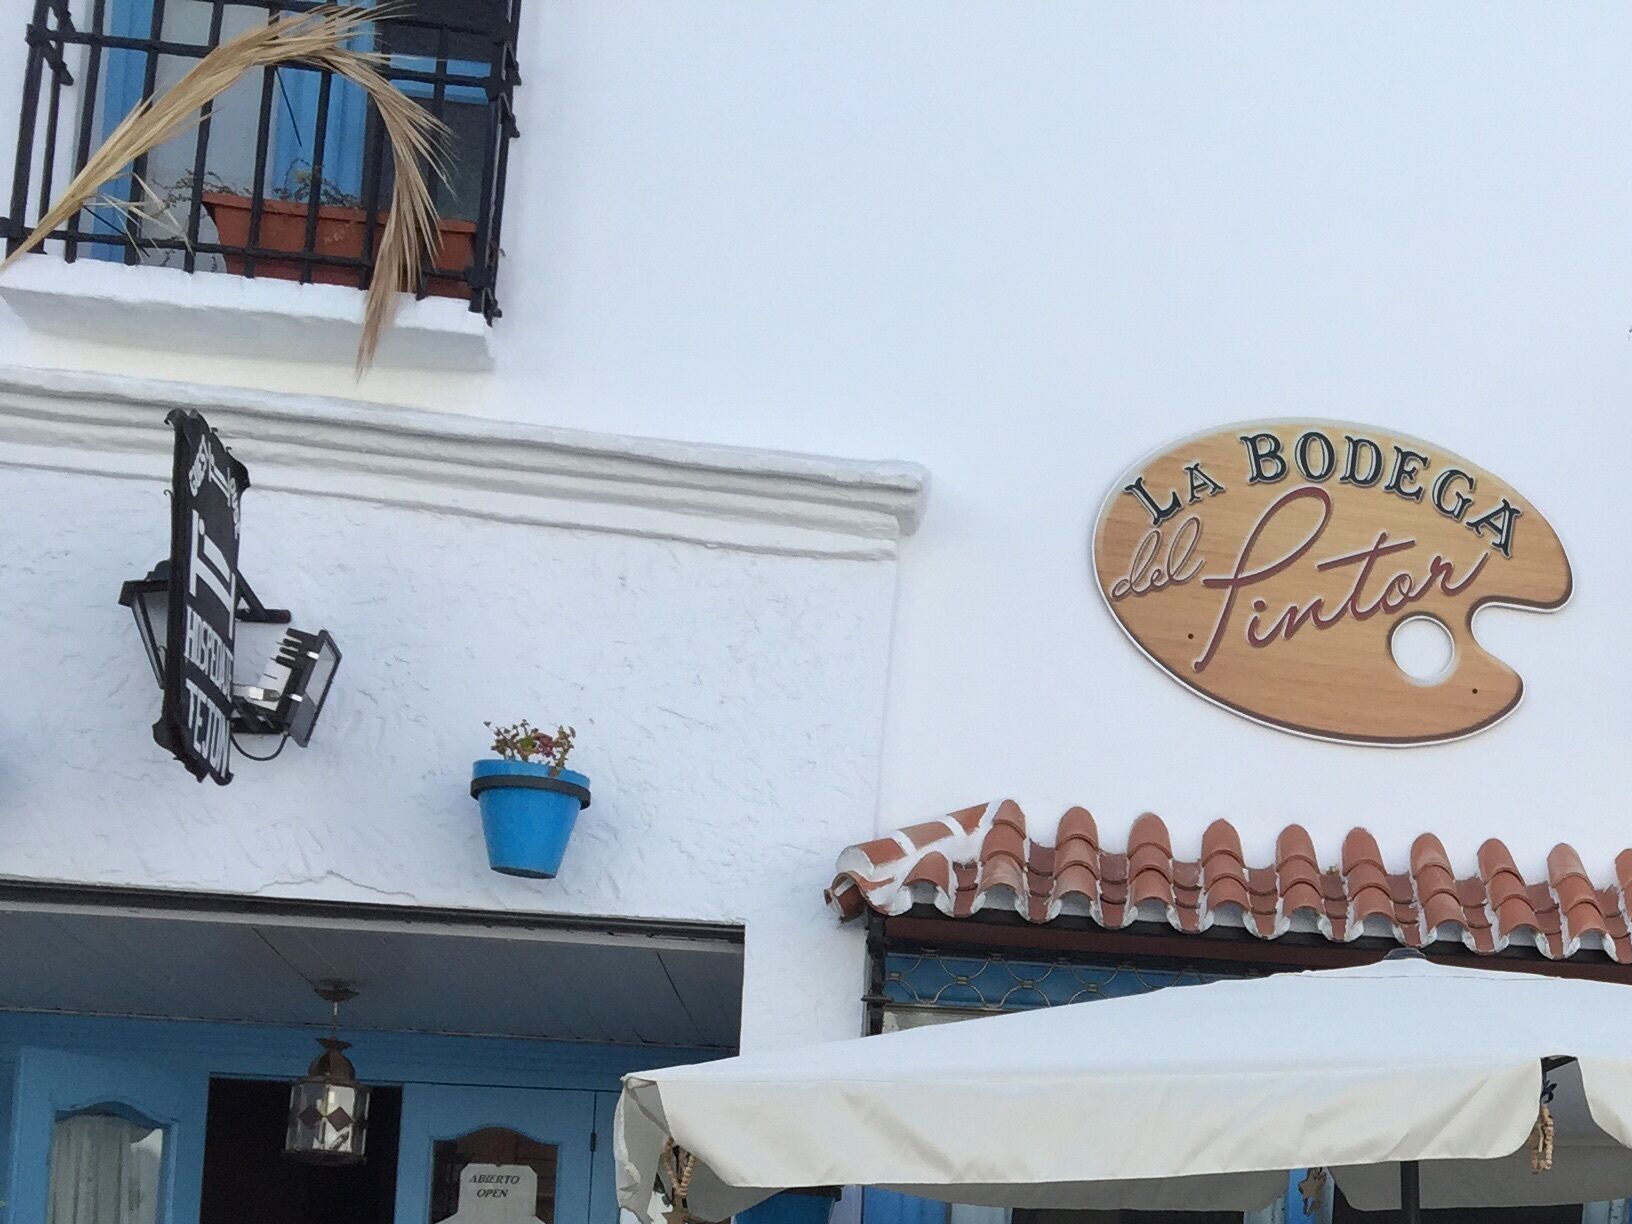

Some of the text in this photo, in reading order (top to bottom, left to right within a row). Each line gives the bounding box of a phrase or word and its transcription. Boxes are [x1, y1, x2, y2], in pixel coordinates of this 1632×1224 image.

[1124, 429, 1525, 557] LA BODEGA
[1109, 486, 1490, 674] del Pintor
[469, 1174, 521, 1185] ABIERTO
[476, 1188, 509, 1199] OPEN
